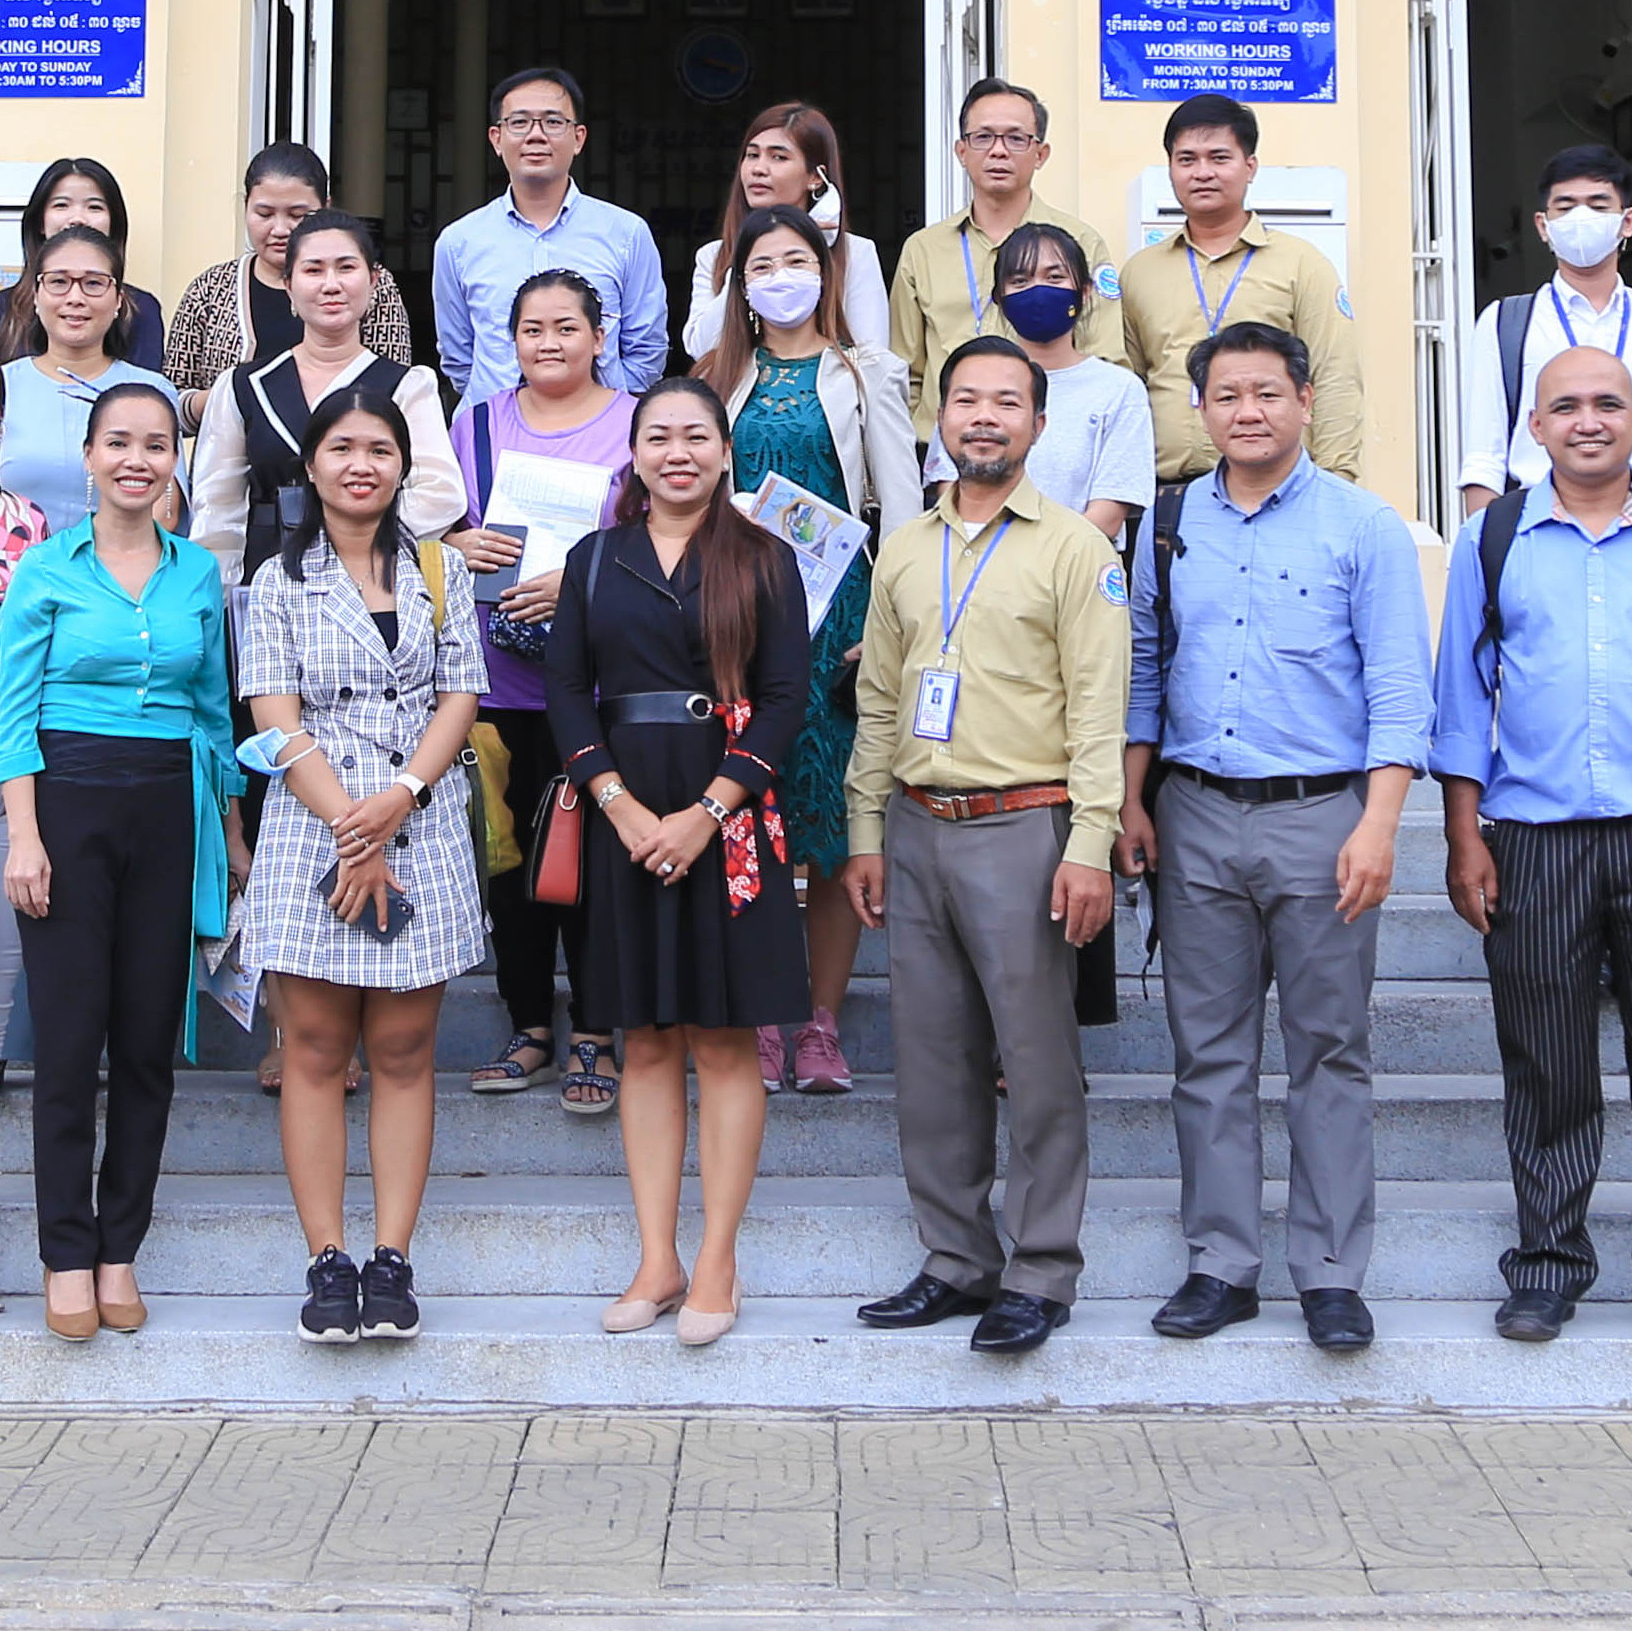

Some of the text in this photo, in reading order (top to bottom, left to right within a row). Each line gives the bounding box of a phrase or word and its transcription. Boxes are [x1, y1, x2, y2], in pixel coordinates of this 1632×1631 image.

[41, 39, 101, 54] HOURS
[1145, 42, 1291, 59] WORKING HOURS
[20, 61, 37, 73] TO
[40, 61, 92, 73] SUNDAY
[1154, 65, 1283, 78] MONDAY TO SUNDAY
[39, 75, 56, 86] TO
[59, 75, 103, 86] 5:30PM
[1142, 78, 1294, 91] FROM 7:30AM TO 5:30PM
